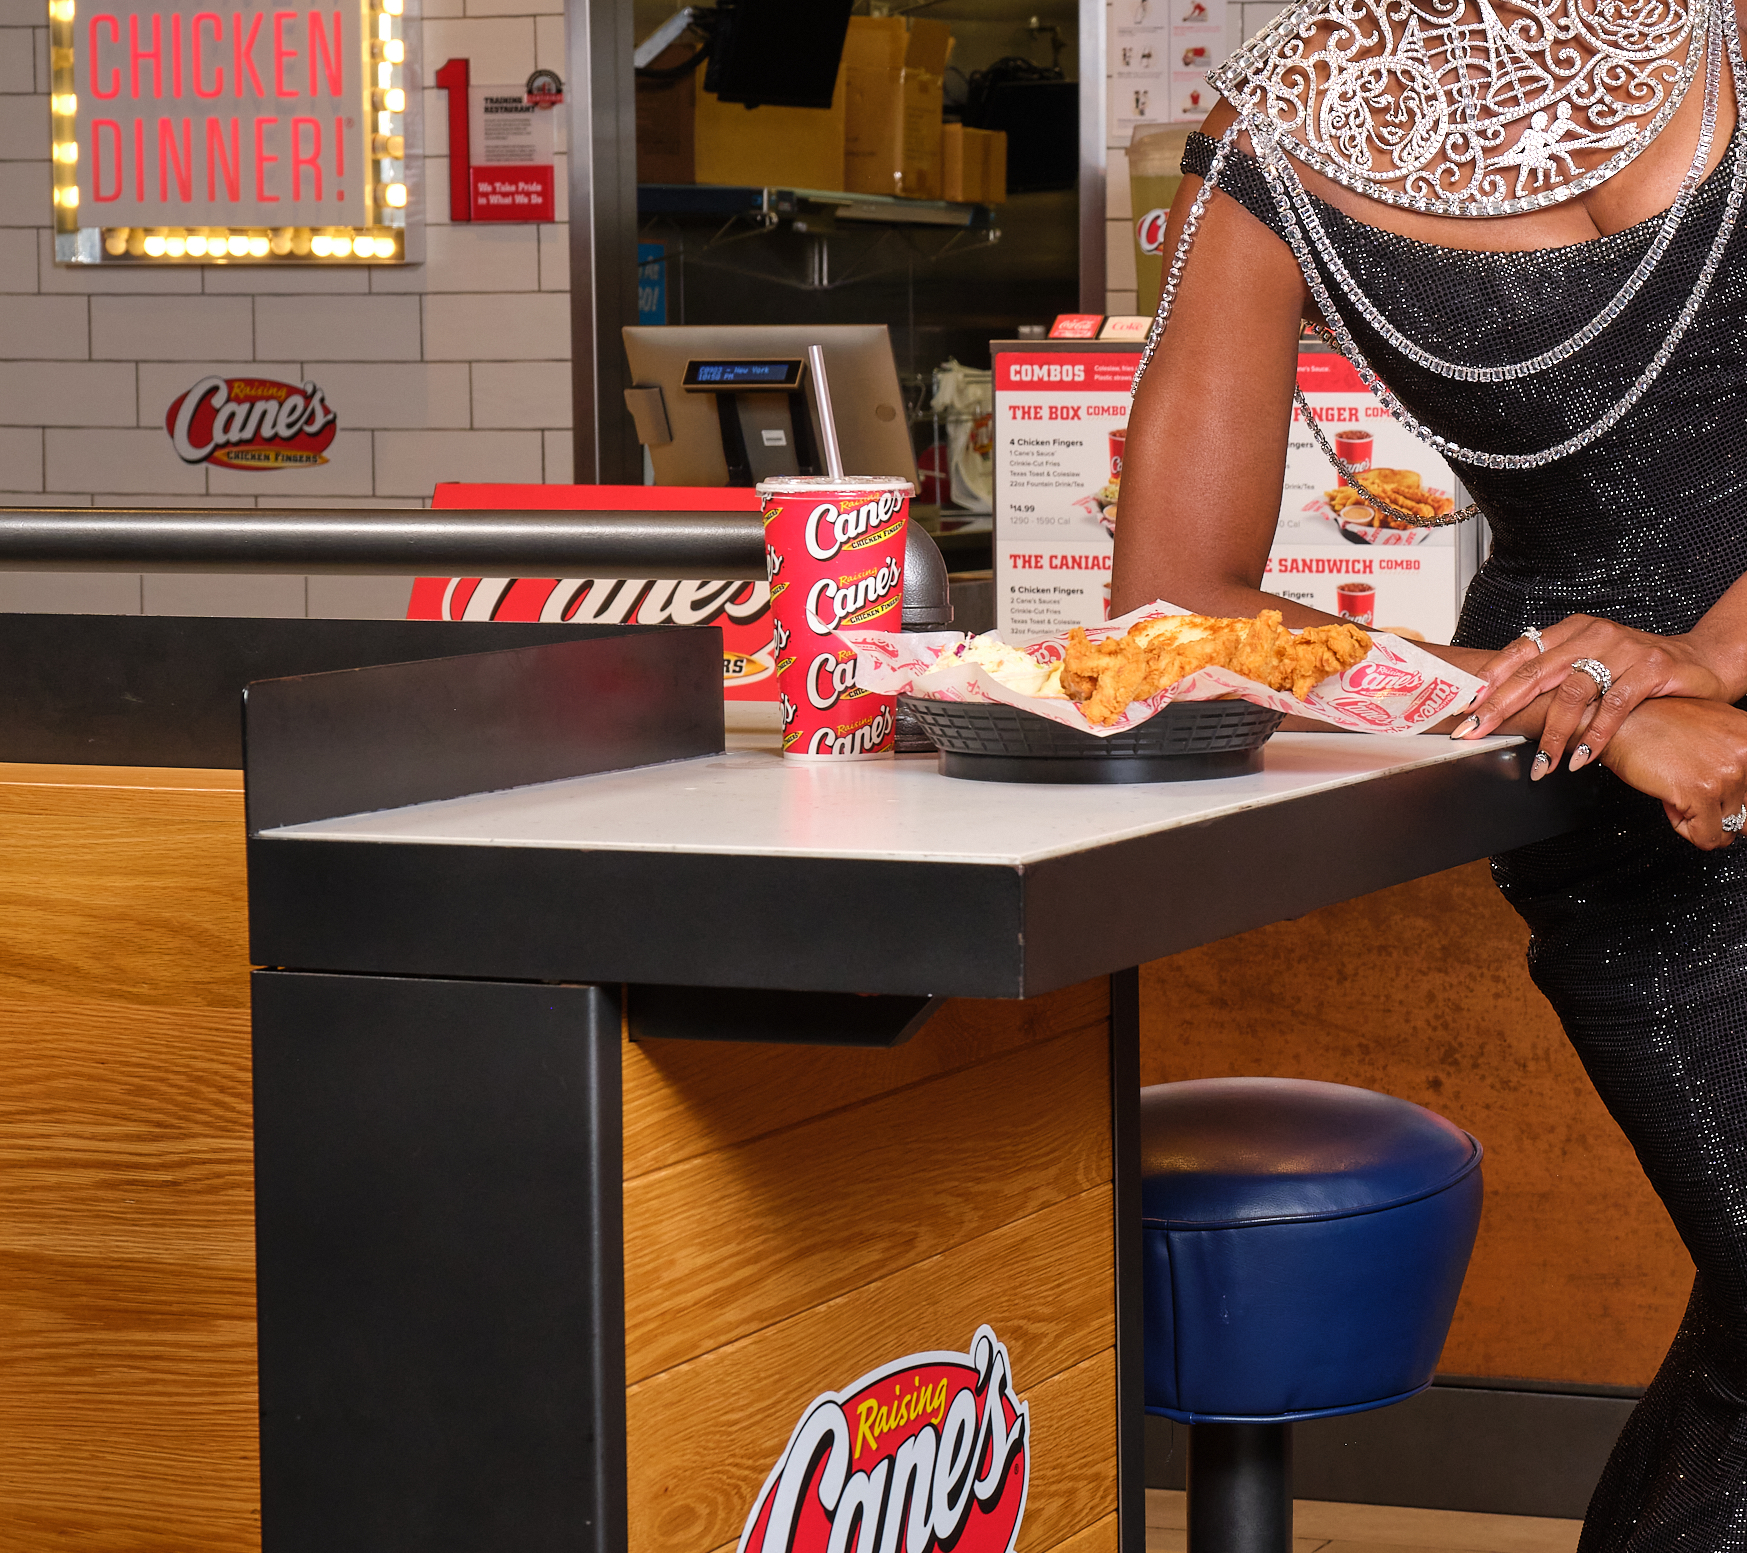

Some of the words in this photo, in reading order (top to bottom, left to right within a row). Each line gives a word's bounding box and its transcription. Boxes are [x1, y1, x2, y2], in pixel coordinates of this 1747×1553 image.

[88, 10, 343, 100] CHICKEN
[90, 115, 345, 203] DINNER!
[478, 183, 492, 192] We
[494, 182, 516, 192] Take
[518, 182, 542, 192] Pride
[489, 195, 512, 204] What
[515, 194, 528, 204] We
[1112, 321, 1142, 331] Coke
[1010, 365, 1085, 381] COMBOS
[231, 382, 287, 401] Raising
[173, 375, 336, 464] Cane's
[1009, 405, 1043, 420] THE
[1049, 406, 1081, 420] BOX
[1087, 406, 1126, 416] COMBO
[1053, 439, 1083, 448] Fingers
[227, 450, 271, 461] CHICKEN
[275, 452, 318, 463] FINGERS
[839, 492, 880, 512] Raising
[1010, 504, 1035, 512] $14.99
[805, 490, 905, 562] Cane's
[851, 533, 882, 549] CHICKEN
[1010, 554, 1043, 569] THE
[1049, 555, 1111, 570] CANIAC
[1279, 558, 1373, 574] SANDWICH
[1379, 560, 1420, 570] COMBO
[839, 567, 877, 587] Raising
[805, 556, 901, 636] Cane's
[1054, 587, 1084, 595] Fingers
[850, 609, 880, 624] CHICKEN
[1341, 662, 1424, 692] Cane's
[1377, 666, 1404, 677] Raising
[808, 705, 894, 754] Cane's
[837, 716, 873, 735] Raising
[854, 1376, 948, 1459] Raising
